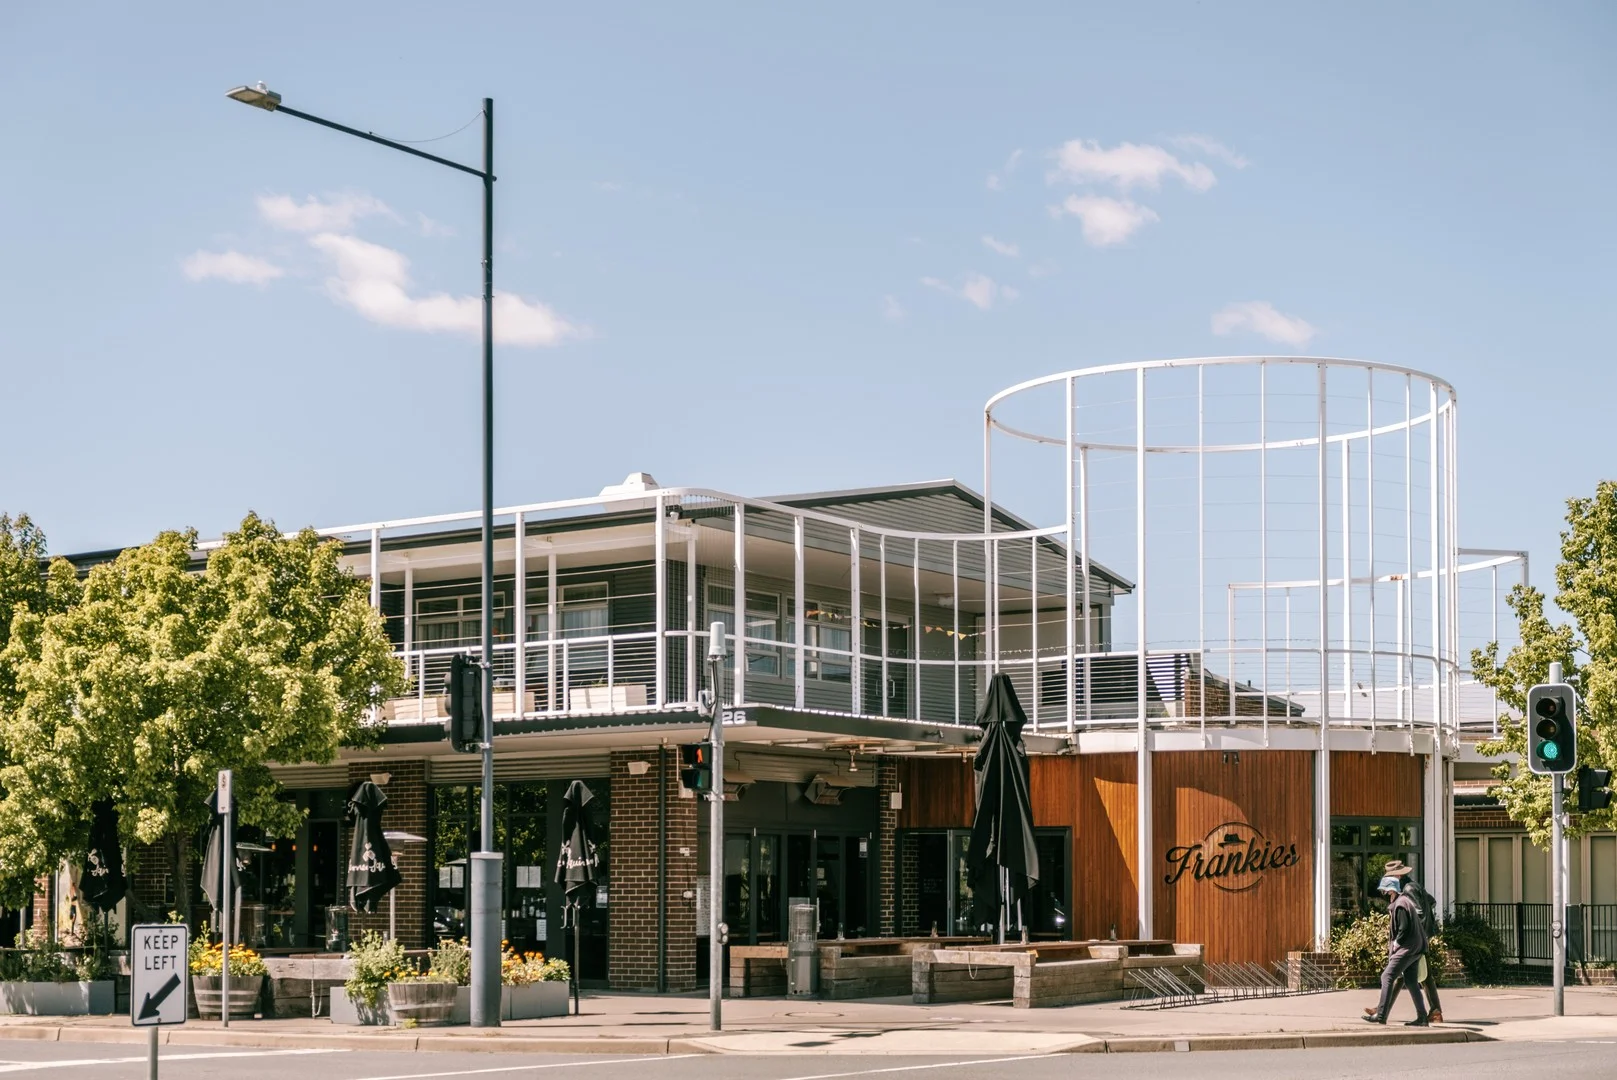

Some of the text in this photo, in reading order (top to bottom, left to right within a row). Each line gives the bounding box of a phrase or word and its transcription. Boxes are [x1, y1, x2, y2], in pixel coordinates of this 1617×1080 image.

[722, 710, 746, 725] 26
[1164, 837, 1301, 884] Frankies
[144, 935, 179, 950] KEEP
[144, 955, 177, 970] LEFT
